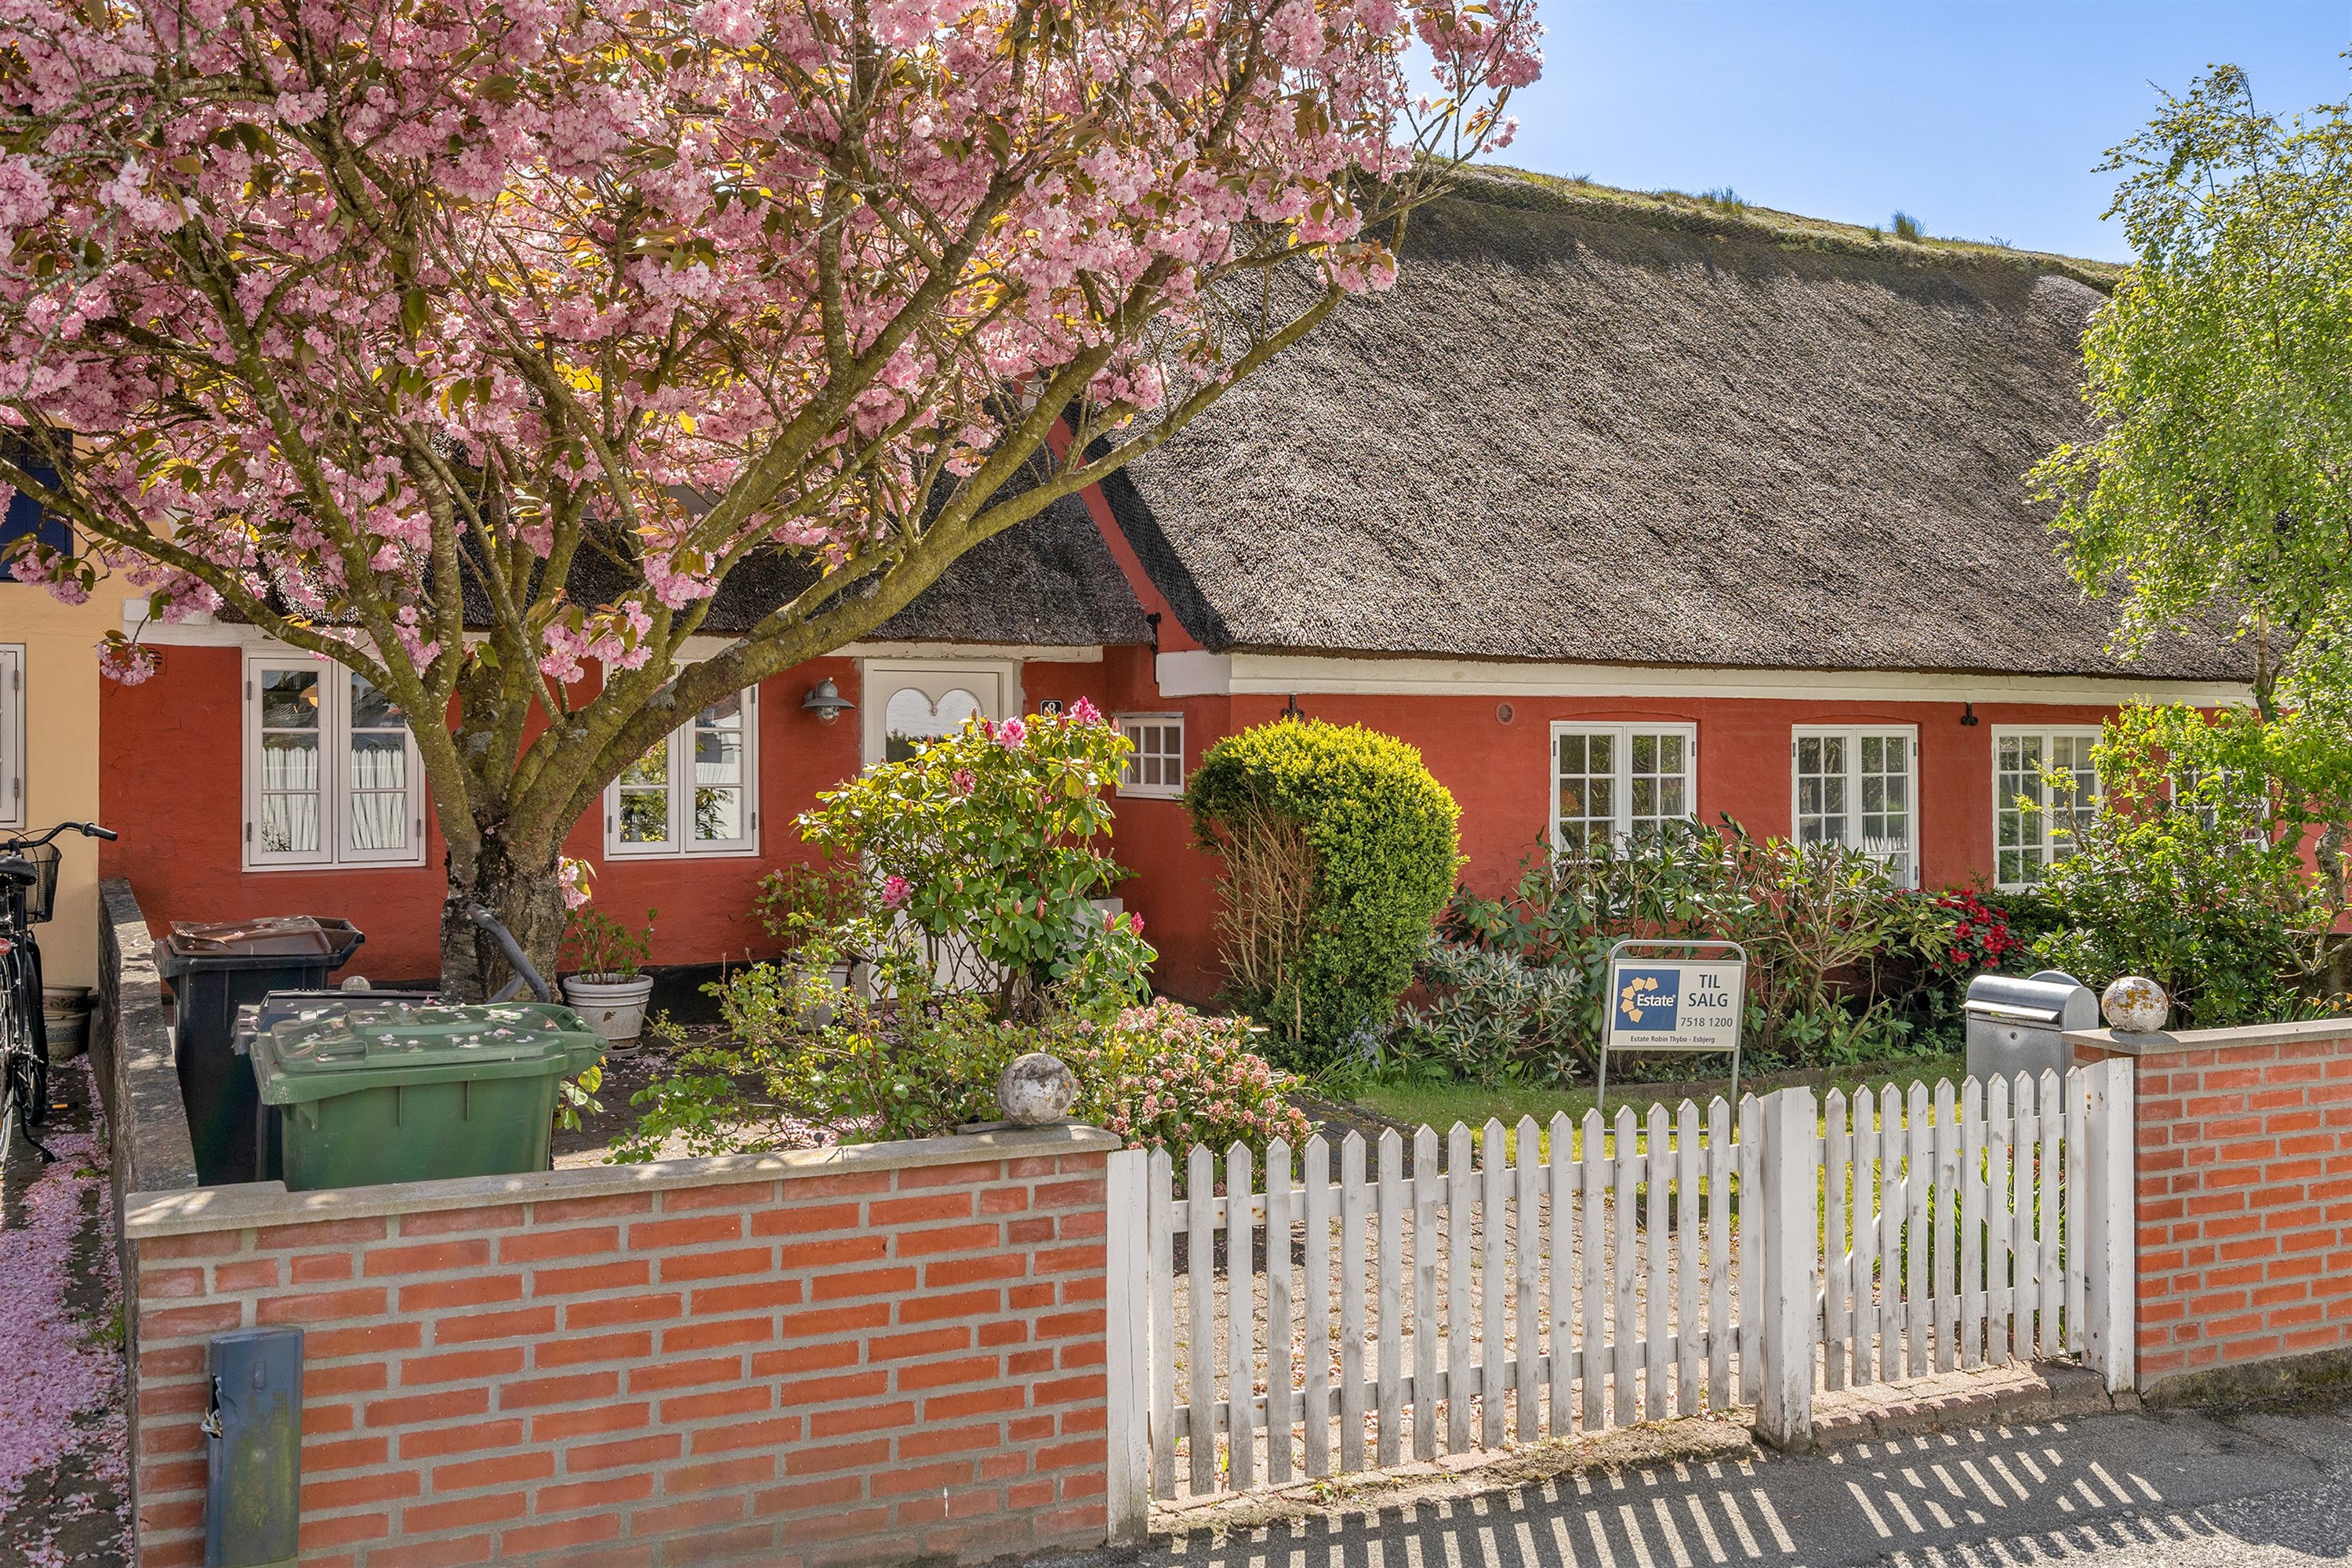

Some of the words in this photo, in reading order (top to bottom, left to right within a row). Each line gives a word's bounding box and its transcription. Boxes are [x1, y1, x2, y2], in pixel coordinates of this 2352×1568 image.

[1047, 702, 1057, 716] 8
[1699, 975, 1721, 989] TIL
[1688, 993, 1729, 1007] SALG
[1680, 1017, 1705, 1027] 7518
[1709, 1017, 1733, 1028] 1200
[1693, 1036, 1715, 1044] Esbjerg
